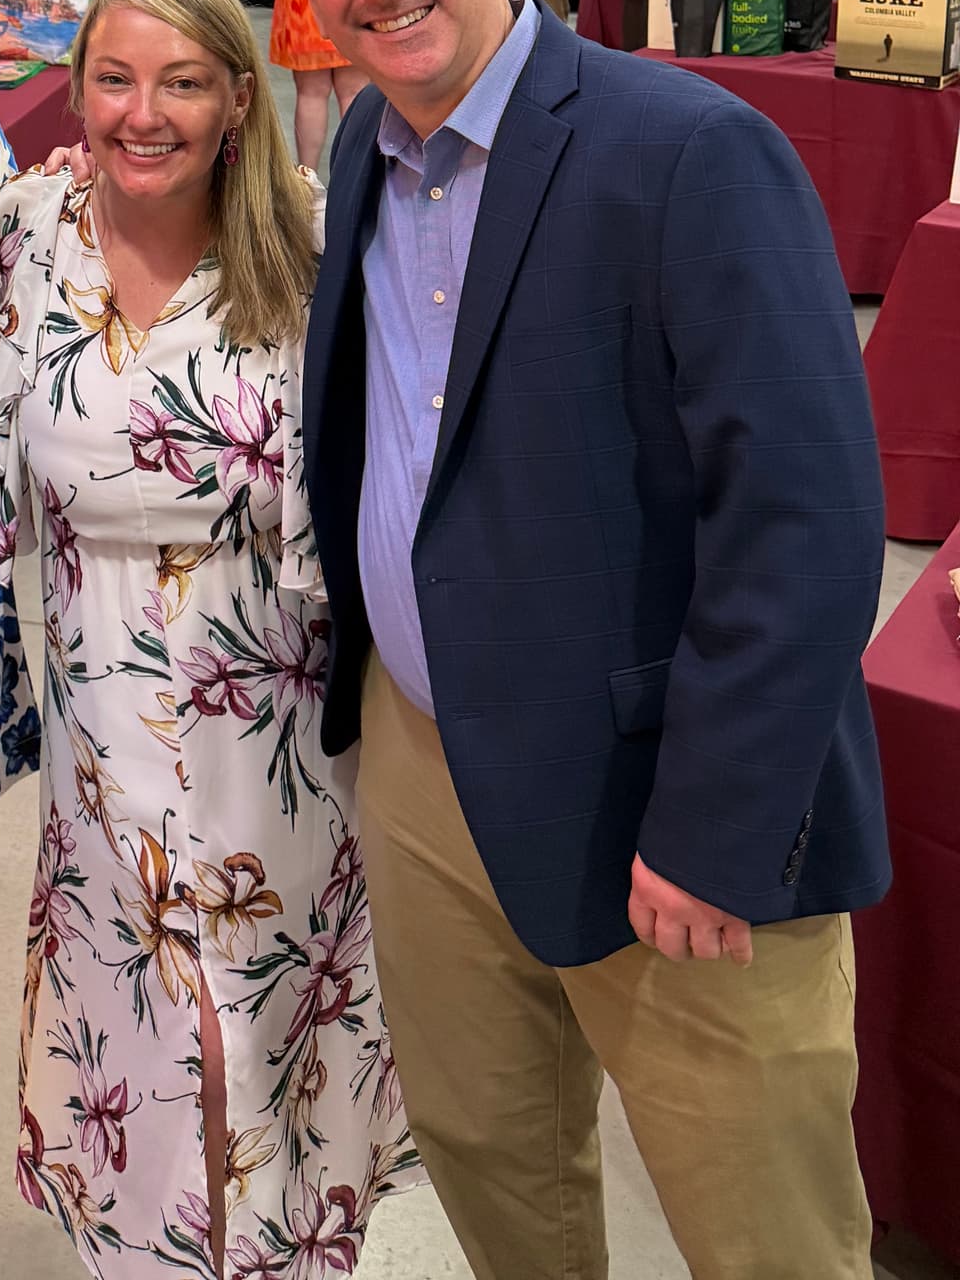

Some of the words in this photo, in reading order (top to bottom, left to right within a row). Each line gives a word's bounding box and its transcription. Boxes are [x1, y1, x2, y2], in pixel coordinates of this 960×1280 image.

[865, 7, 894, 16] COLUMBIA
[895, 9, 917, 17] VALLEY
[732, 13, 768, 23] bodied
[732, 24, 758, 36] fruity
